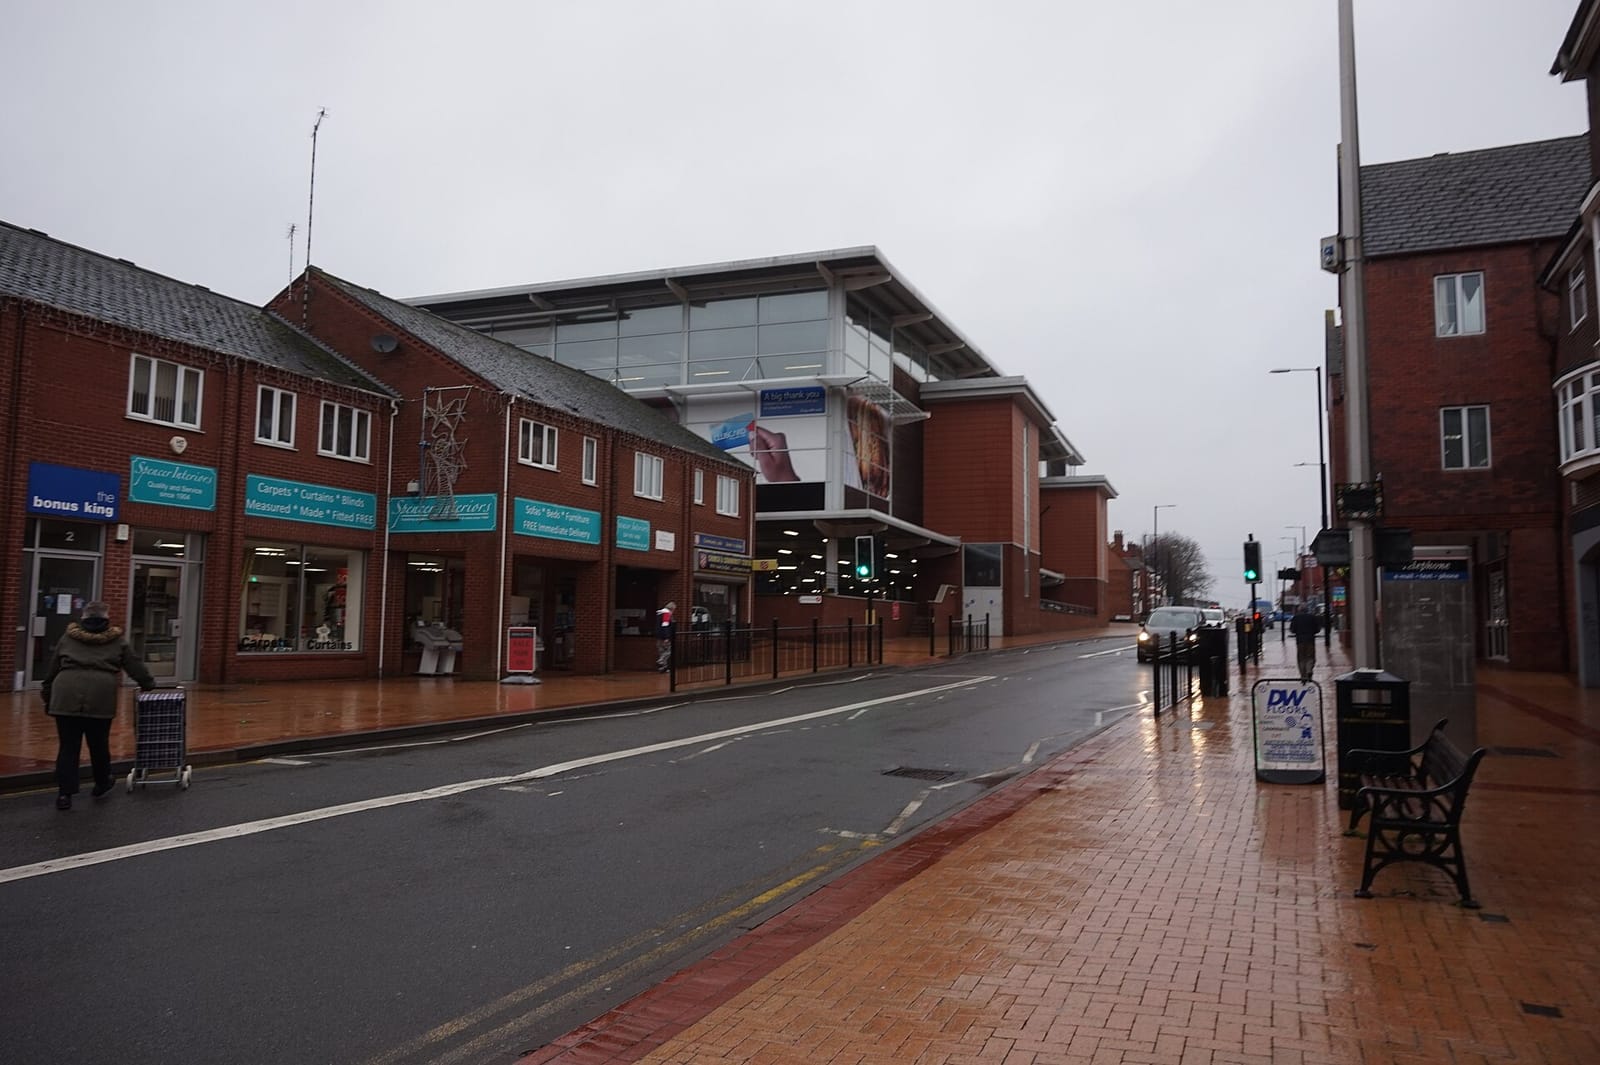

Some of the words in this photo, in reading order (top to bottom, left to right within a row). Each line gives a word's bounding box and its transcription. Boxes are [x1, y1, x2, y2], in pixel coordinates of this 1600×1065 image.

[133, 461, 173, 487] Spencer
[172, 466, 213, 485] Interiors
[147, 481, 169, 491] Quality
[181, 485, 203, 495] Service
[257, 482, 292, 497] Carpets
[300, 489, 335, 503] Curtains
[341, 495, 365, 508] Blinds
[97, 491, 114, 503] the
[32, 495, 79, 512] bonus
[83, 501, 114, 518] king
[245, 498, 291, 514] Measured
[299, 506, 325, 518] Made
[332, 511, 355, 522] Fitted
[355, 513, 374, 525] FREE
[65, 531, 75, 542] 2
[523, 520, 538, 532] FREE
[538, 524, 569, 536] Immediate
[568, 527, 591, 539] Delivery
[1402, 560, 1452, 572] elephone
[240, 637, 288, 652] Carpets
[307, 639, 353, 650] Curtains
[1267, 689, 1308, 706] DW
[1266, 705, 1308, 714] FLOORS
